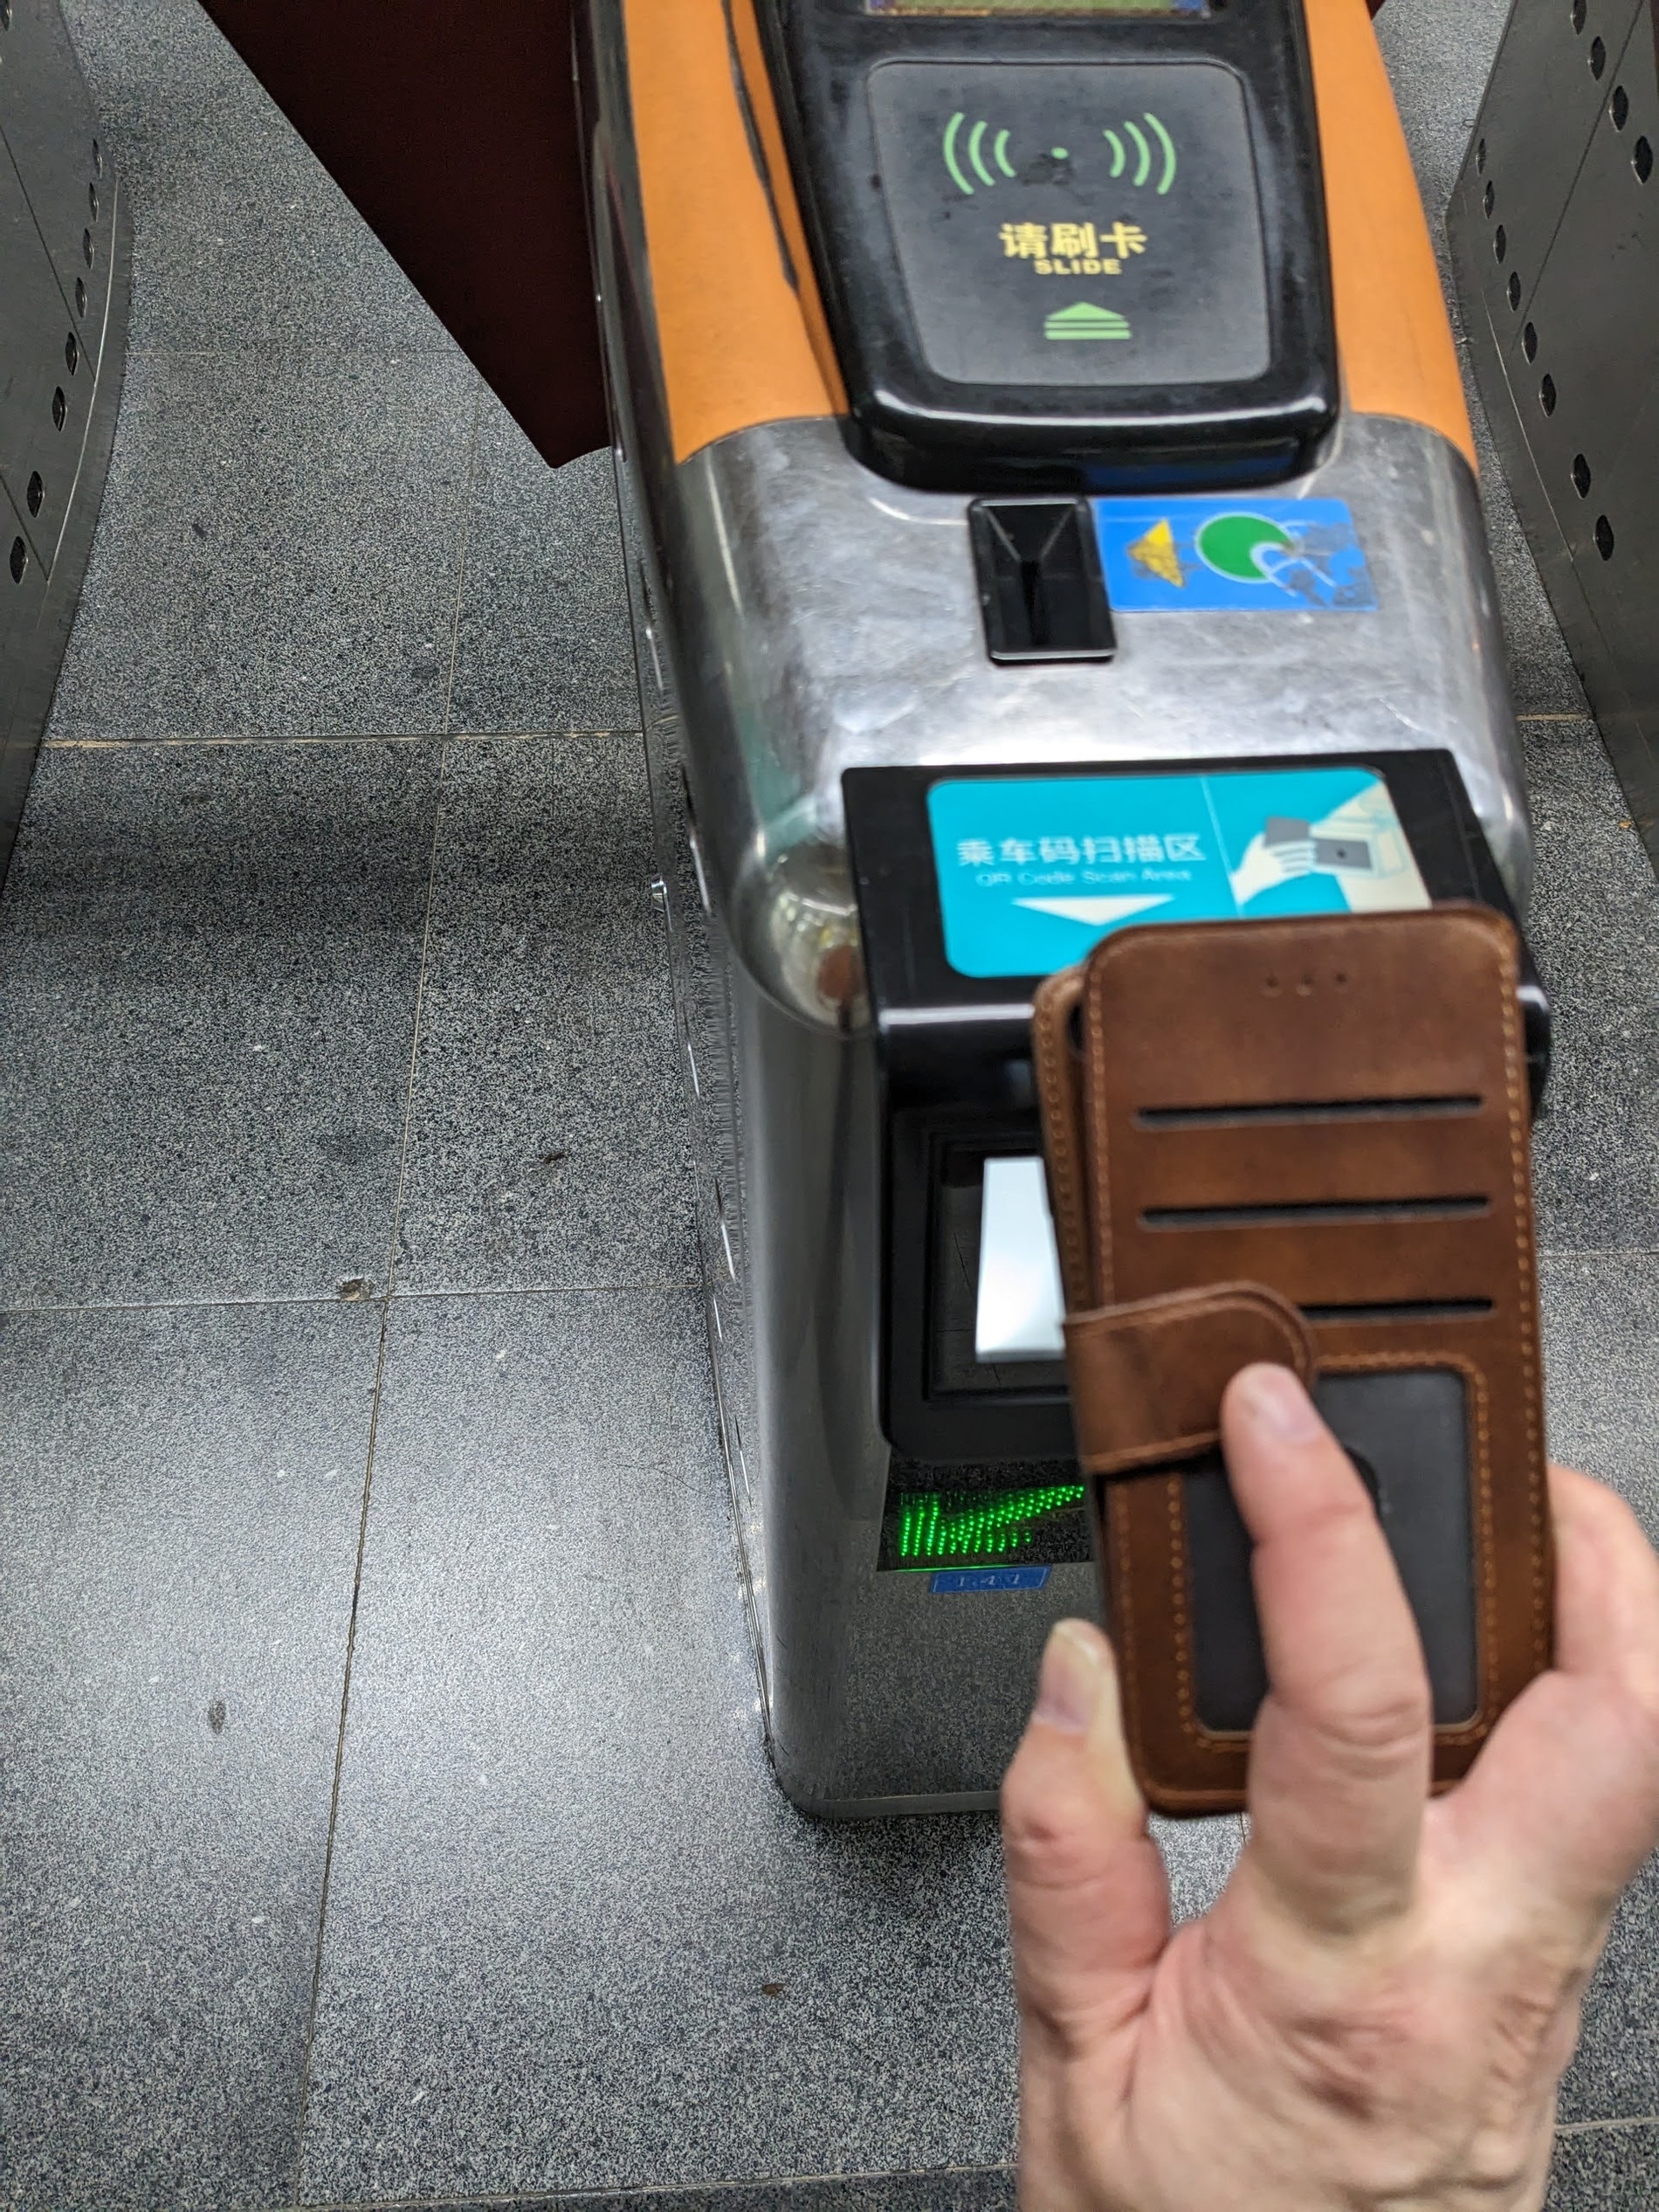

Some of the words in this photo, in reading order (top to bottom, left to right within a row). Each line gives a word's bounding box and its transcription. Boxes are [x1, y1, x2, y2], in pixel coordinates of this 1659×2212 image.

[998, 222, 1147, 258] 请刷卡
[1034, 258, 1122, 275] SLIDE
[957, 832, 1207, 866] 乘车码扫描区
[975, 872, 1012, 886] QR
[1017, 870, 1075, 886] Code
[1081, 869, 1138, 885] Scan
[1141, 867, 1192, 882] Area
